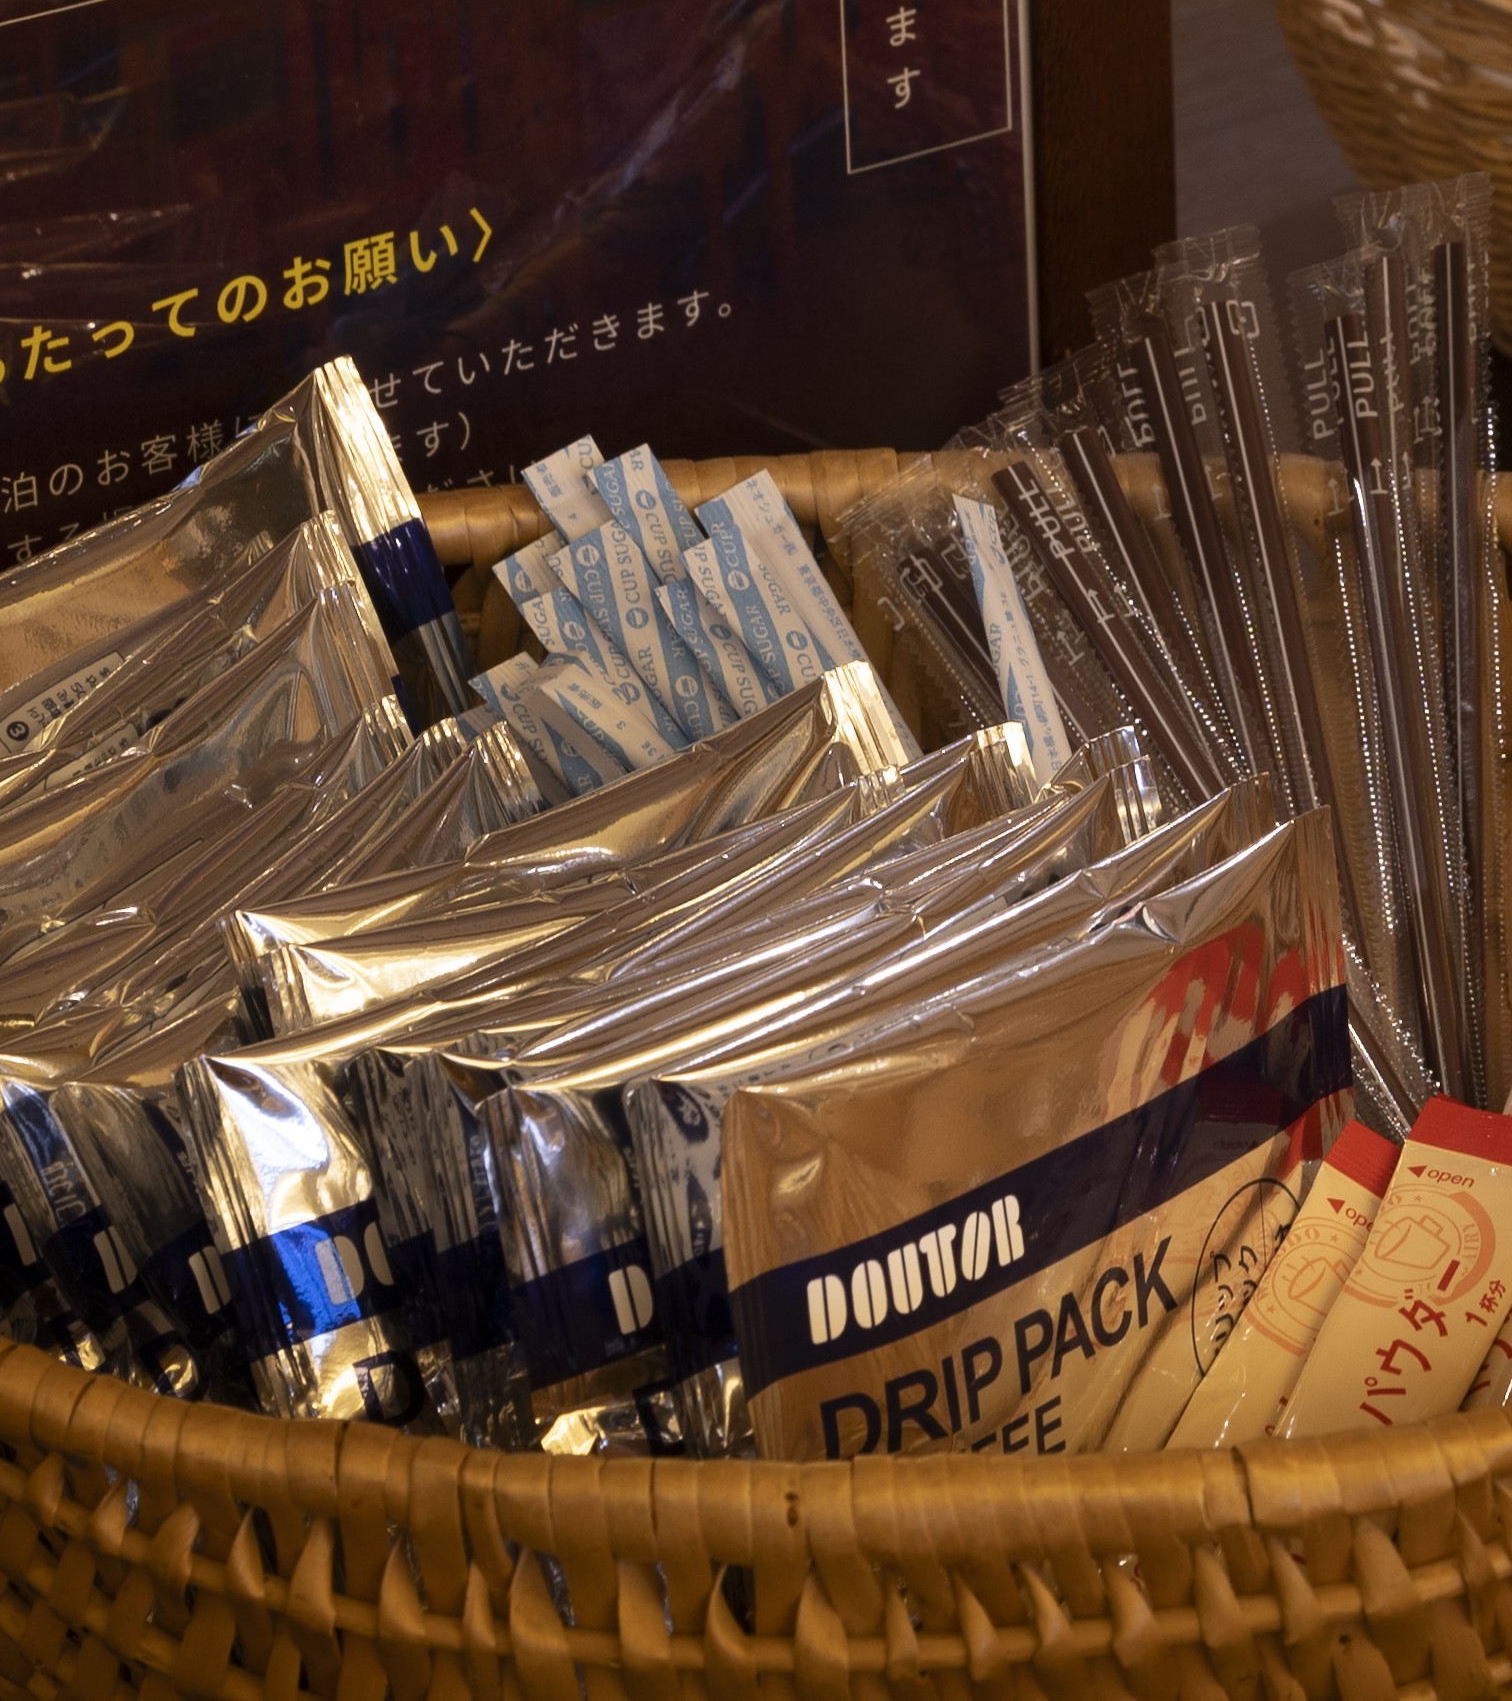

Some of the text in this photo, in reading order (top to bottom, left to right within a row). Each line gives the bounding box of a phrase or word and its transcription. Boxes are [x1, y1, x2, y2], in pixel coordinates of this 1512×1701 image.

[1304, 348, 1335, 440] PULL
[1347, 330, 1379, 419] PULL
[644, 511, 669, 547] CUP
[1018, 478, 1076, 560] PULL
[619, 569, 641, 607] CUP
[722, 641, 747, 682] CUP
[512, 703, 537, 736] CUP
[1426, 1168, 1476, 1189] open
[805, 1193, 1026, 1347] DOUTOR
[820, 1336, 1002, 1460] DRIP
[1014, 1235, 1179, 1395] PACK
[1359, 1259, 1461, 1426] パウダー
